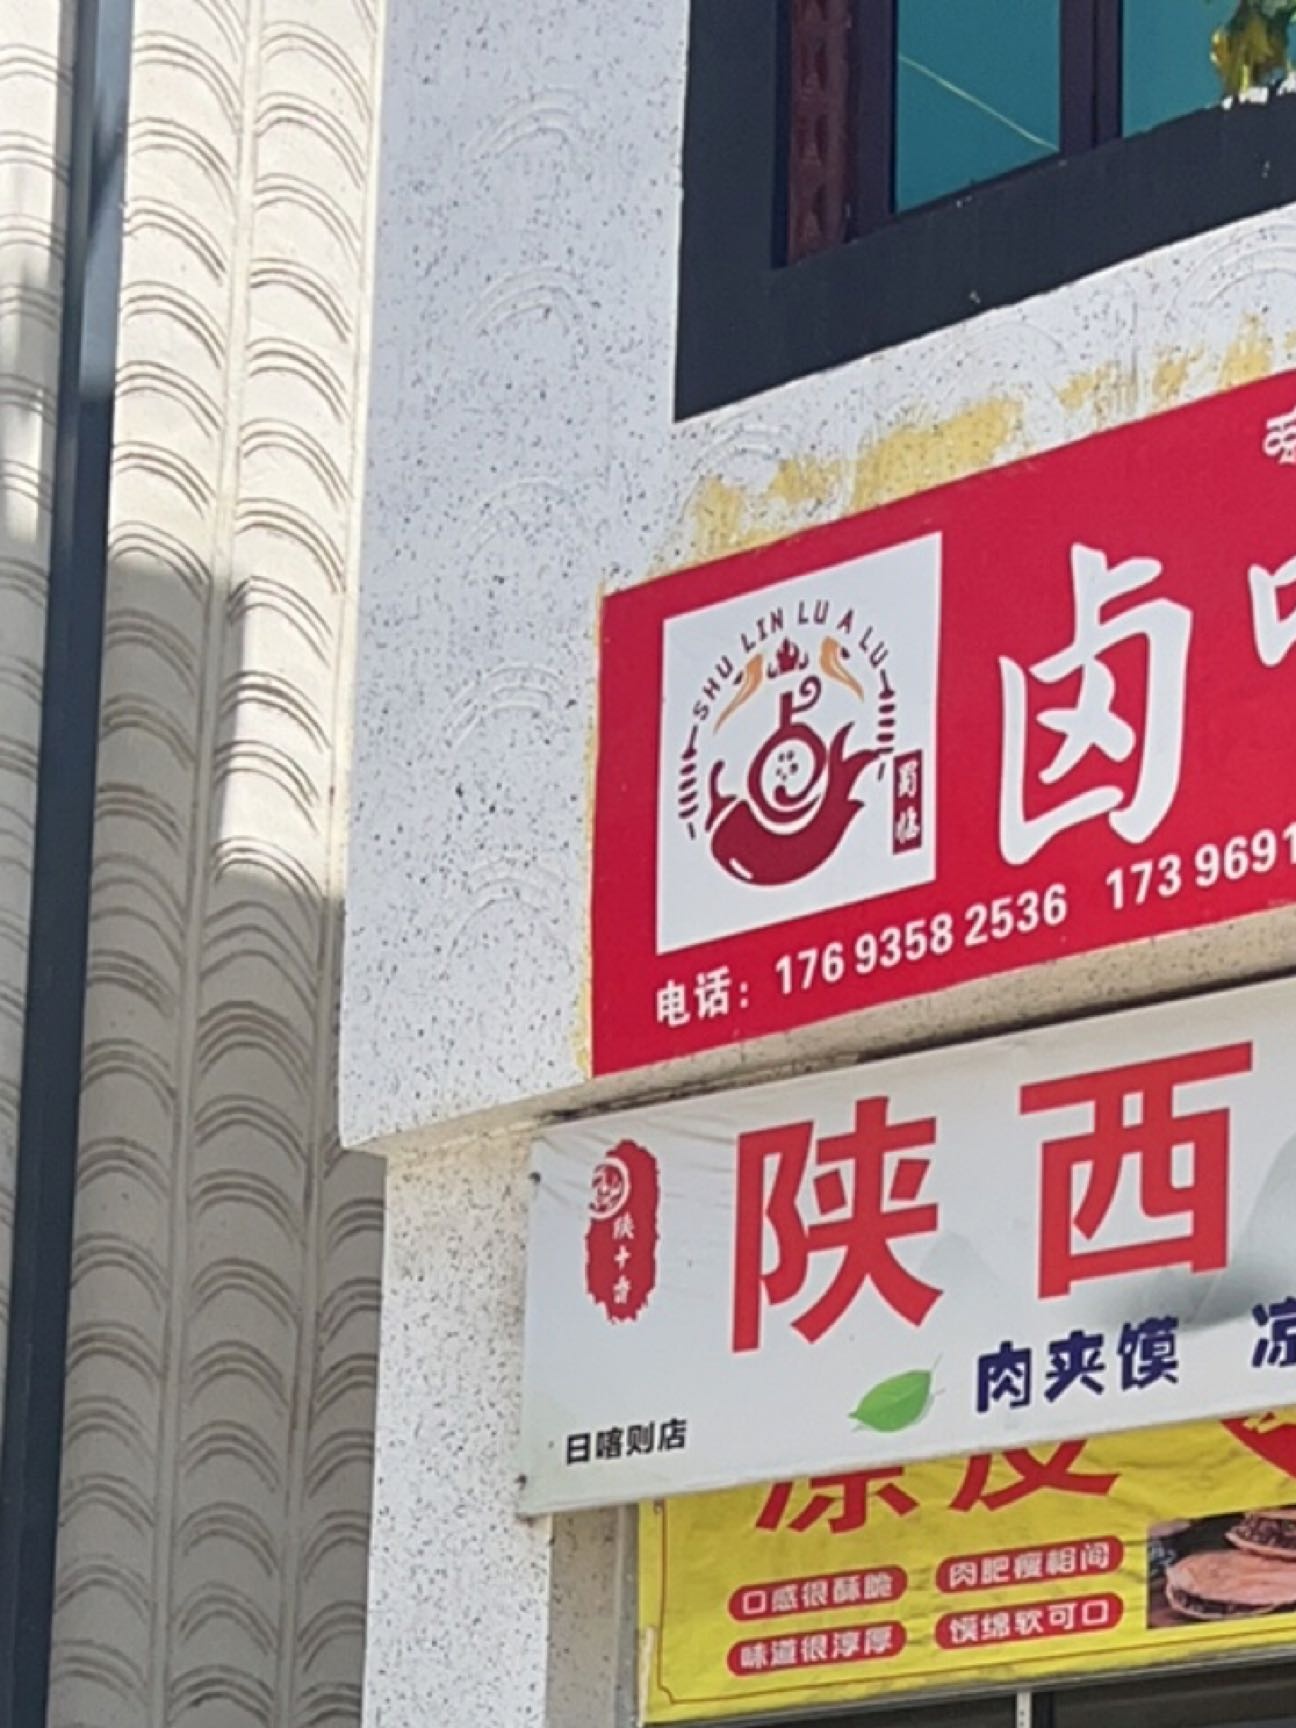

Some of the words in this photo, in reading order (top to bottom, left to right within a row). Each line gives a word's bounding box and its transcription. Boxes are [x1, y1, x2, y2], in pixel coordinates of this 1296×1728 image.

[692, 655, 734, 721] SHU
[740, 607, 784, 654] LIN
[798, 600, 829, 625] LU
[836, 609, 855, 634] A
[858, 626, 889, 668] LU
[656, 966, 750, 1028] 电话：
[776, 941, 845, 995] 176
[855, 912, 954, 974] 9358
[964, 883, 1068, 947] 2536
[1107, 857, 1182, 912] 173
[976, 1316, 1180, 1413] 肉夹馍
[567, 1417, 687, 1466] 日喀则店
[950, 1541, 1110, 1590] 肉肥瘦相间
[740, 1625, 892, 1670] 味道很淳厚
